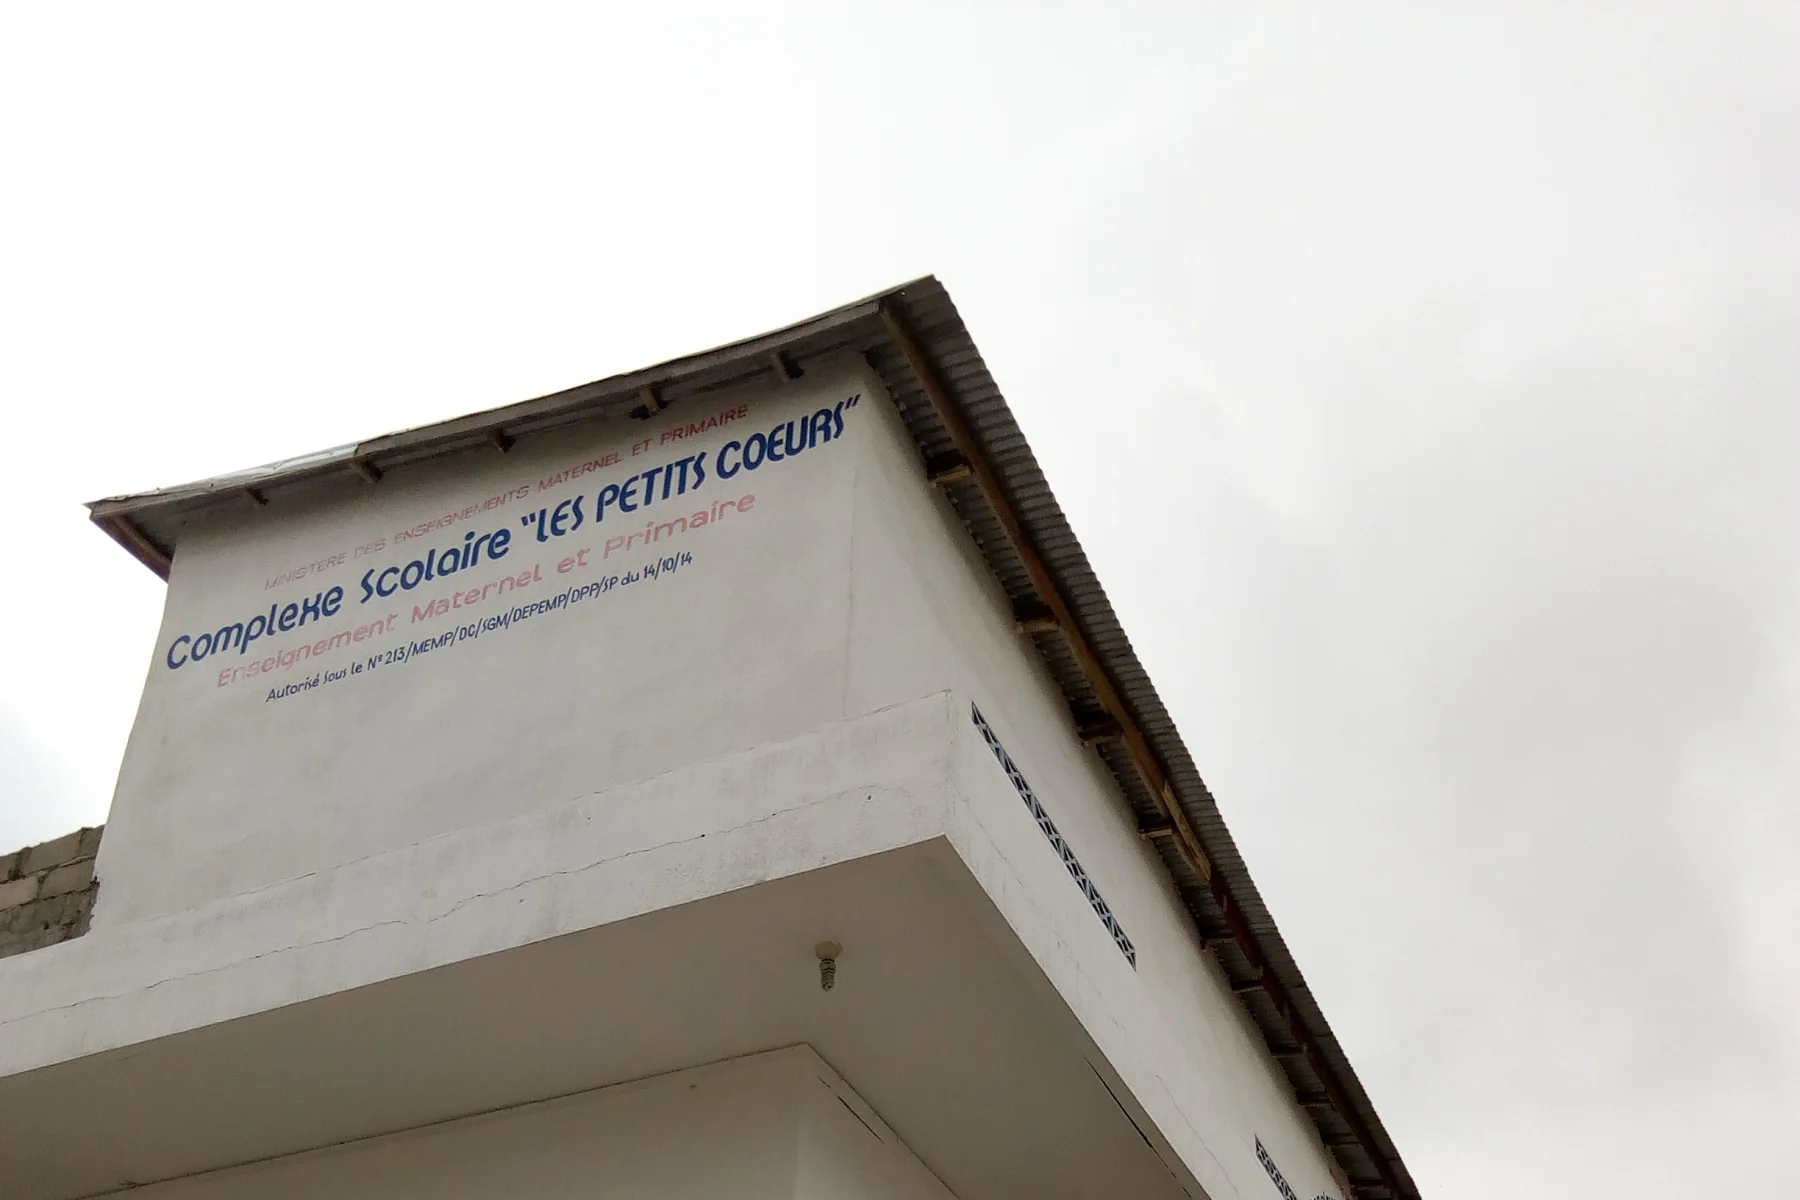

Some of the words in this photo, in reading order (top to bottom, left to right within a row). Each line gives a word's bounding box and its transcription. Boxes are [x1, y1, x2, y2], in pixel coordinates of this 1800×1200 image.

[167, 586, 344, 669] Complexe
[360, 528, 512, 604] Scolaire
[596, 452, 707, 523] PETITS
[353, 538, 387, 559] DES
[538, 451, 622, 491] MATERNEL
[631, 438, 653, 457] ET
[660, 404, 749, 446] PRIMAIRE
[217, 613, 399, 688] Enseignement
[411, 564, 543, 624] Maternel
[557, 548, 591, 574] et
[603, 494, 756, 559] Primaire
[266, 672, 320, 702] Autorisé
[351, 661, 364, 675] le
[621, 571, 640, 586] du
[643, 551, 693, 581] 14/10/14
